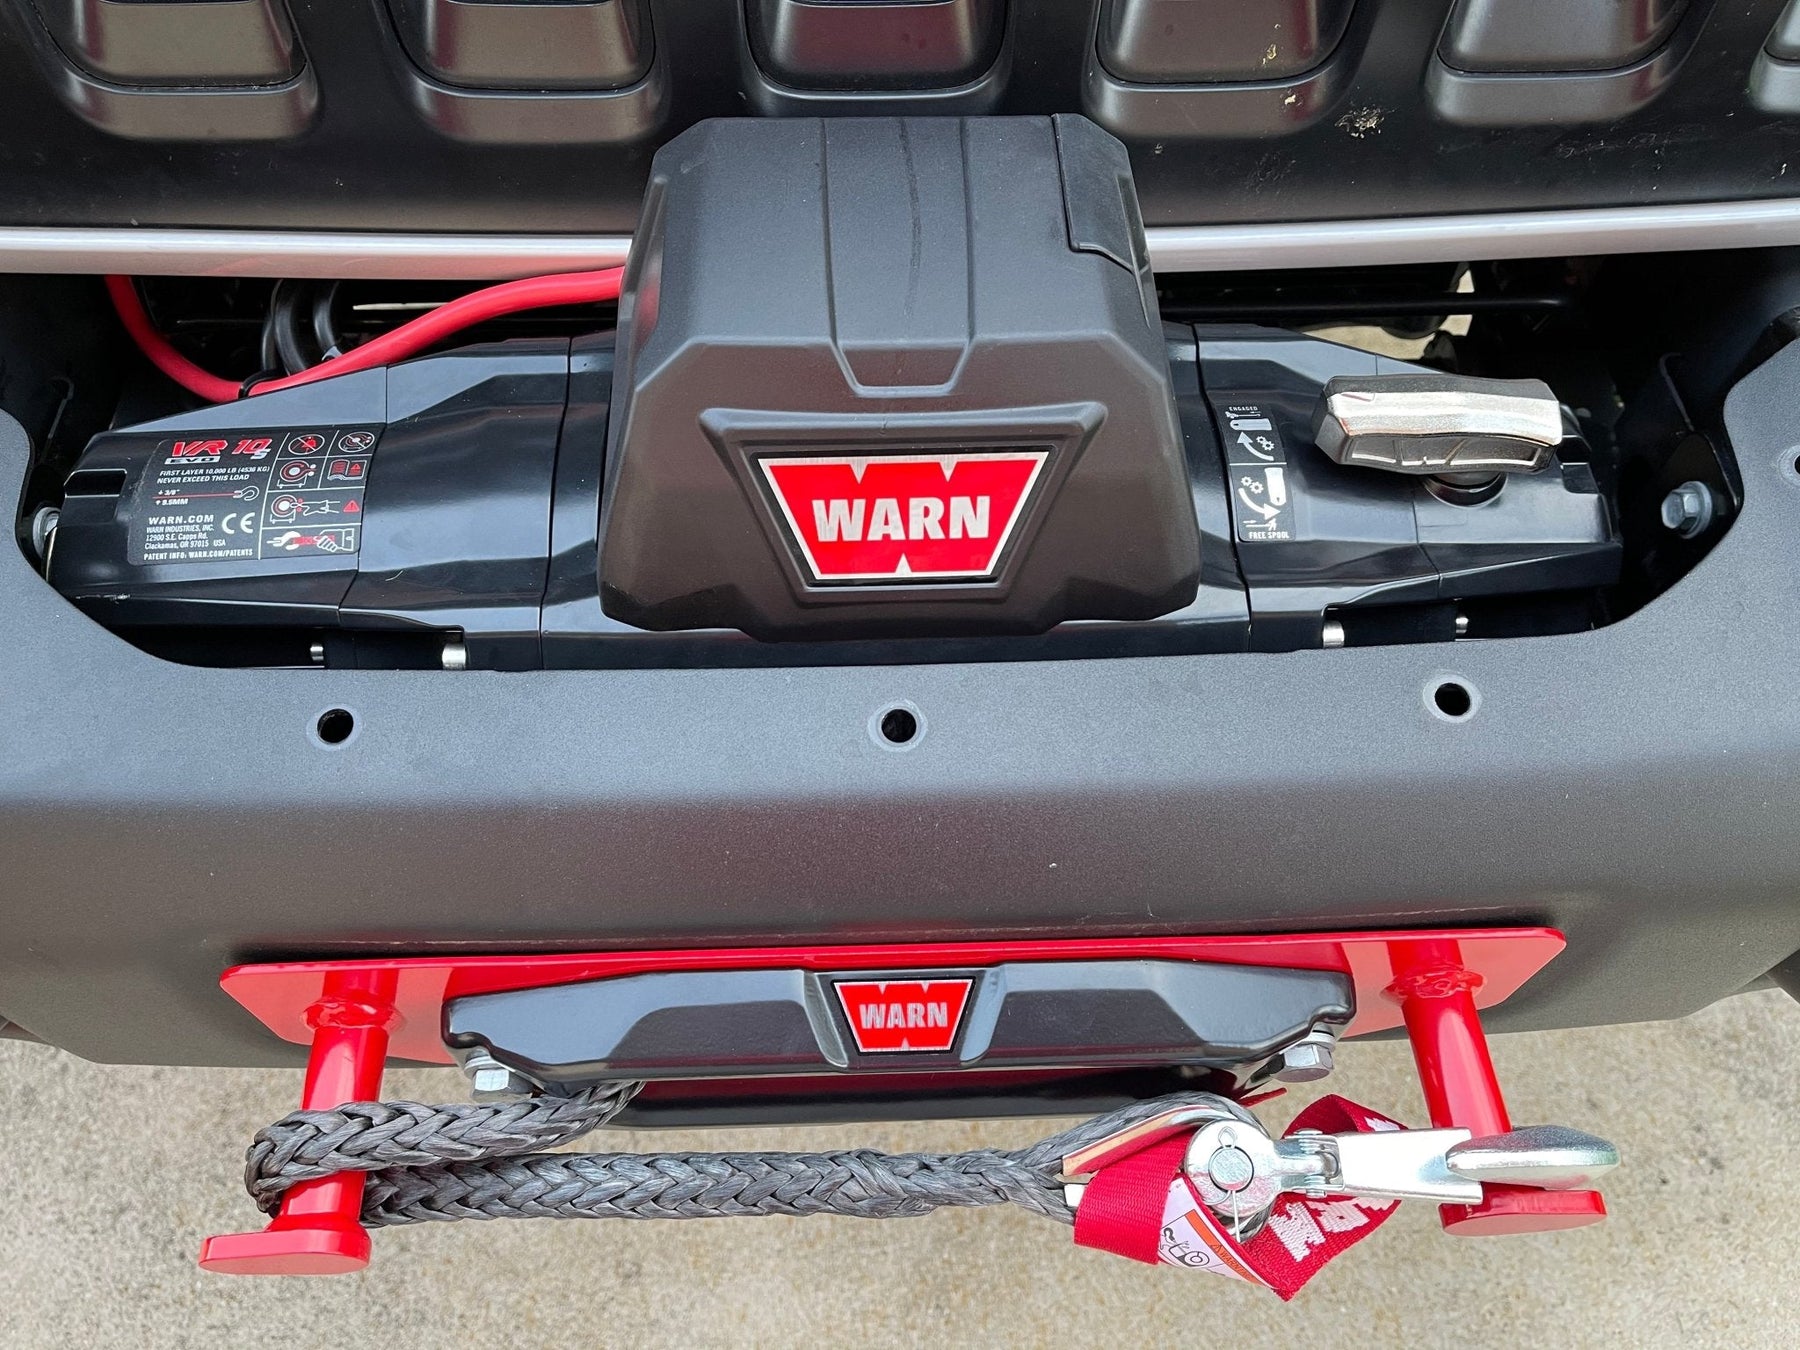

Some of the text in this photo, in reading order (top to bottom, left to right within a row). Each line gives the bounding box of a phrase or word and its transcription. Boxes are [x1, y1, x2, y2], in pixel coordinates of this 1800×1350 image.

[172, 440, 228, 457] VR
[168, 456, 217, 464] EVO
[257, 465, 270, 473] KG)
[157, 476, 181, 484] NEVER
[182, 475, 209, 483] EXCEED
[148, 514, 214, 525] WARN.COM
[222, 512, 256, 534] CE
[811, 495, 990, 543] WARN
[178, 533, 197, 541] Capps
[1249, 531, 1290, 539] FREE SPOOL
[145, 542, 179, 550] Clackamas,
[190, 540, 209, 548] 97015
[144, 553, 168, 561] PATENT
[188, 549, 253, 559] WARN.COM/PATENTS
[858, 1002, 948, 1029] WARN
